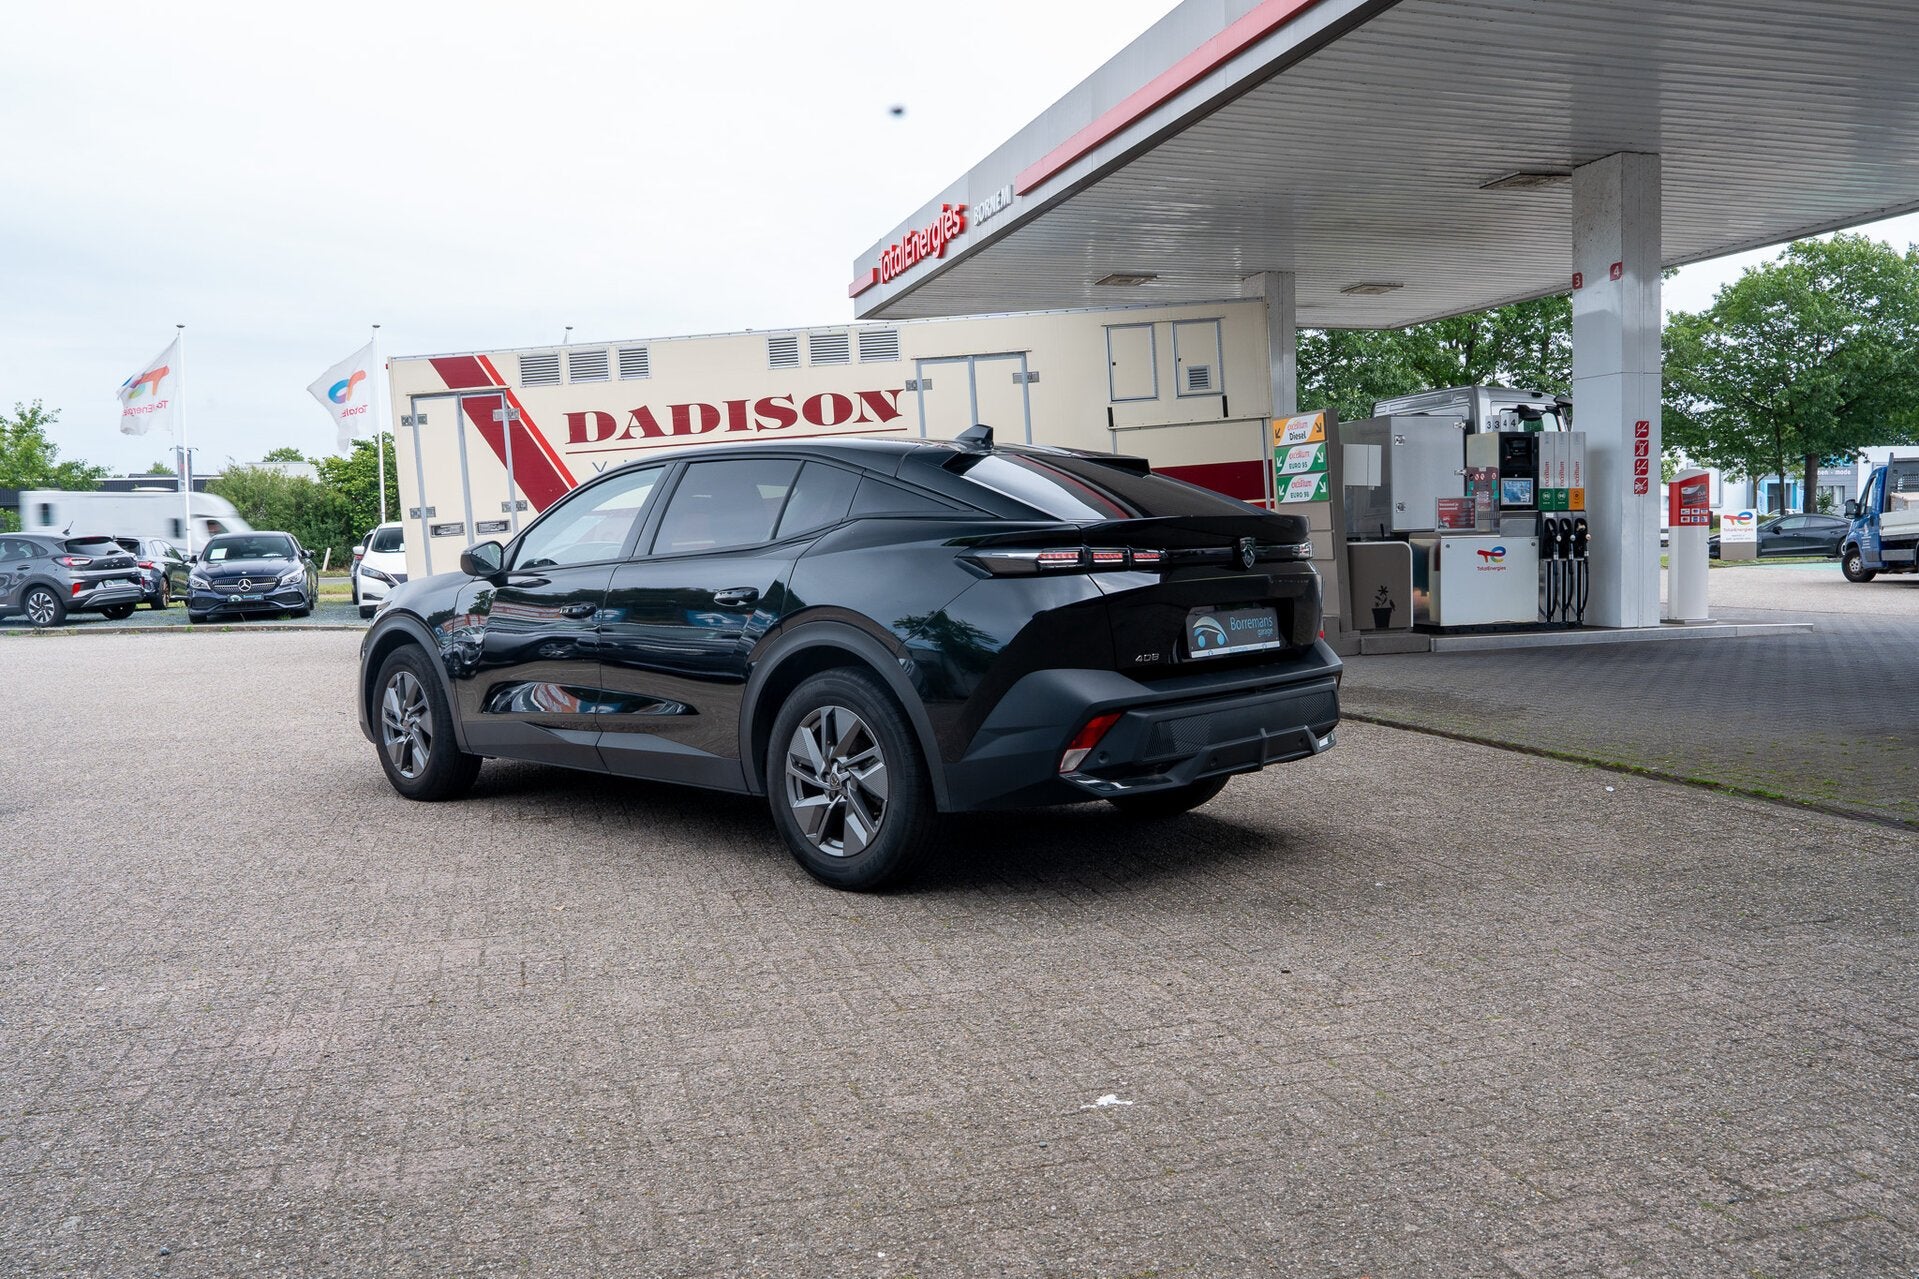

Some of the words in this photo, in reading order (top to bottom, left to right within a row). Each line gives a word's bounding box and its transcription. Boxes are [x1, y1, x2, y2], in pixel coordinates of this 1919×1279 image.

[879, 203, 968, 284] TotalEnergies
[973, 184, 1014, 226] BORNEM
[1614, 265, 1620, 278] 4
[1575, 275, 1581, 287] 3
[563, 389, 904, 445] DADISON
[1289, 431, 1307, 441] Diesel
[1230, 616, 1273, 632] Borremans
[1257, 628, 1273, 638] garage
[1135, 653, 1160, 662] 408
